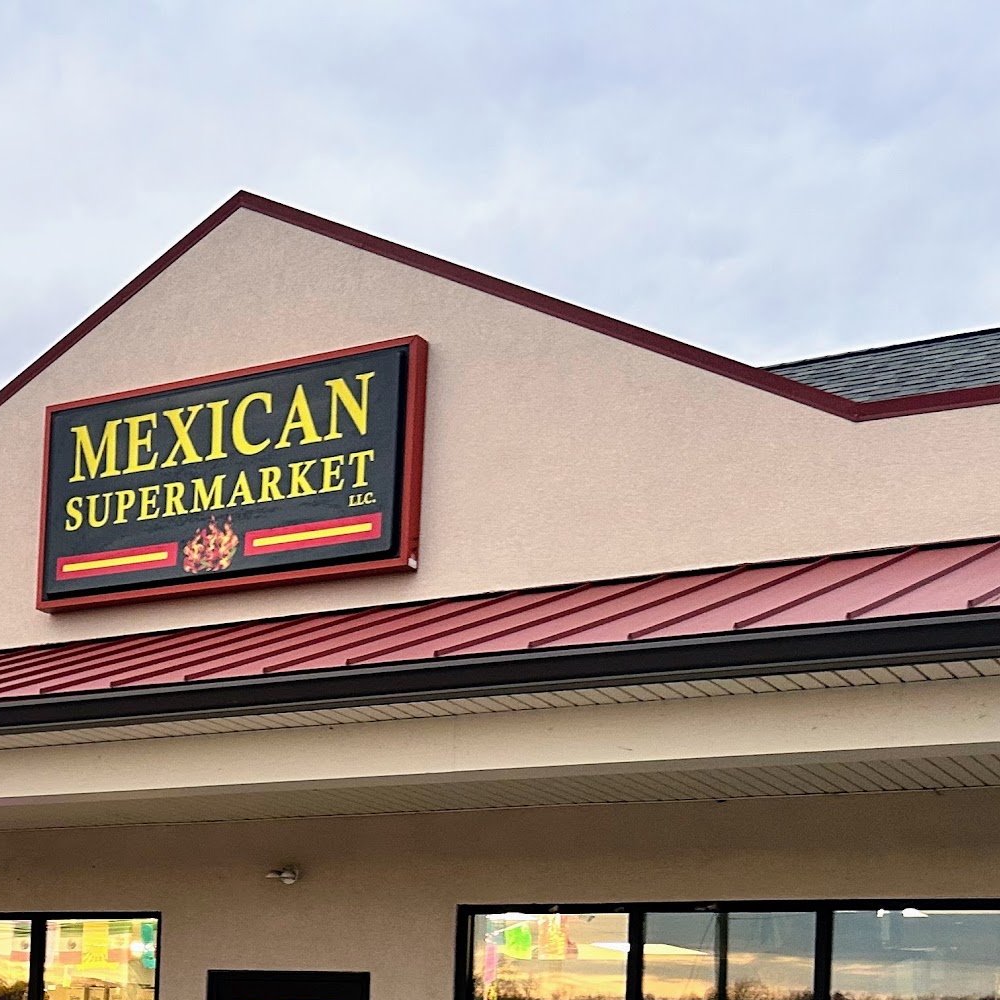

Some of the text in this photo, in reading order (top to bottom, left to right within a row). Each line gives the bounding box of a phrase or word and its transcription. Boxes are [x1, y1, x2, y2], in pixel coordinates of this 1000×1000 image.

[69, 371, 375, 483] MEXICAN
[64, 449, 375, 531] SUPERMARKET
[349, 492, 376, 507] LLC.
